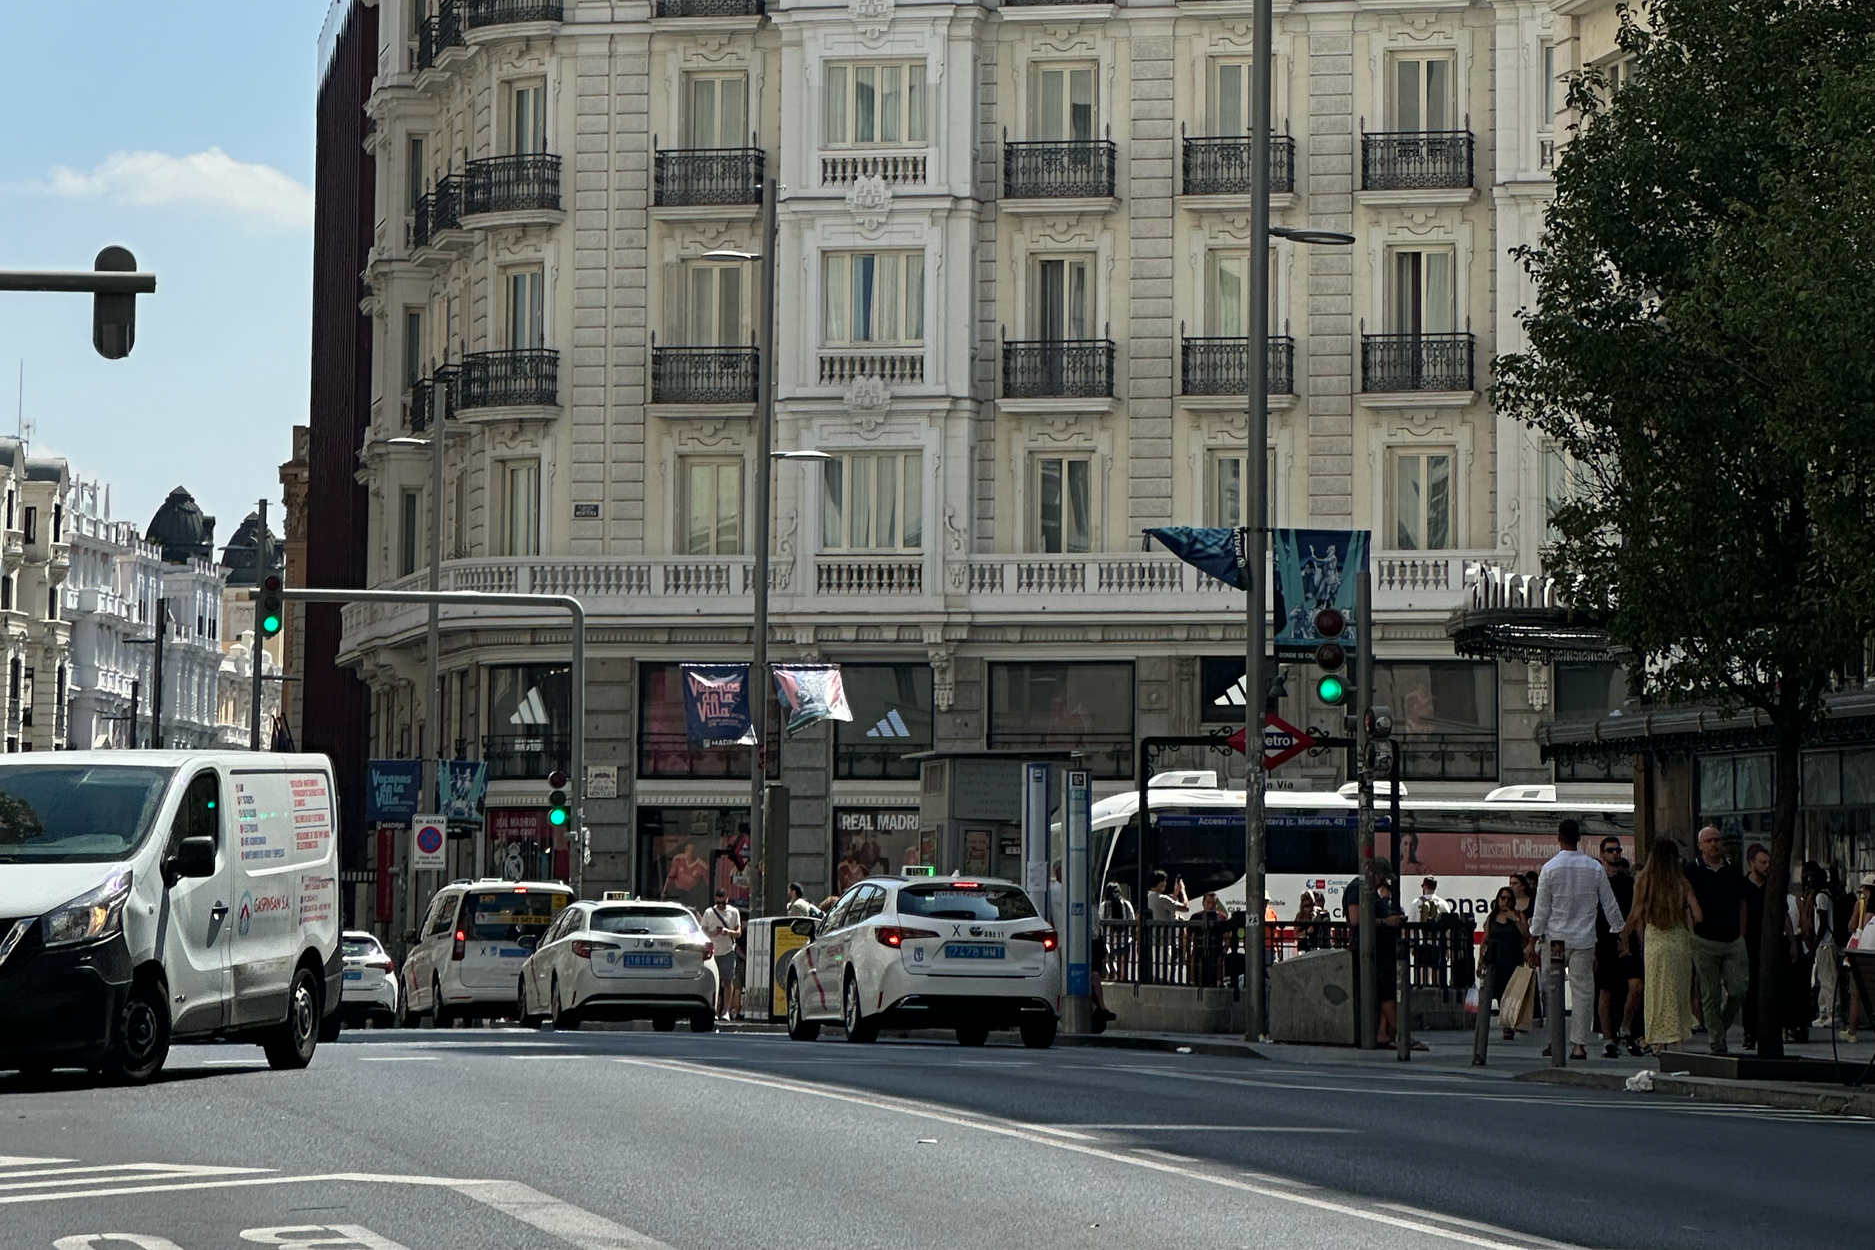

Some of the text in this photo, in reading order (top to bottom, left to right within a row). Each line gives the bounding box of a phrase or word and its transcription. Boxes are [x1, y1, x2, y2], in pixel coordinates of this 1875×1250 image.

[697, 702, 731, 722] Villa
[1265, 735, 1291, 746] etro
[372, 769, 412, 787] Veranos
[380, 782, 404, 793] de la
[375, 791, 399, 808] Villa
[510, 817, 537, 827] MADRID
[842, 814, 919, 830] REAL MADRI
[1198, 817, 1227, 825] Acceso
[1264, 818, 1284, 826] ntera
[1460, 837, 1479, 858] #Se
[1479, 838, 1512, 859] buscan
[1512, 838, 1562, 859] CoRazon
[1327, 886, 1339, 894] de
[952, 924, 961, 937] X
[633, 938, 640, 948] J
[480, 947, 486, 956] X
[952, 946, 979, 957] 7478
